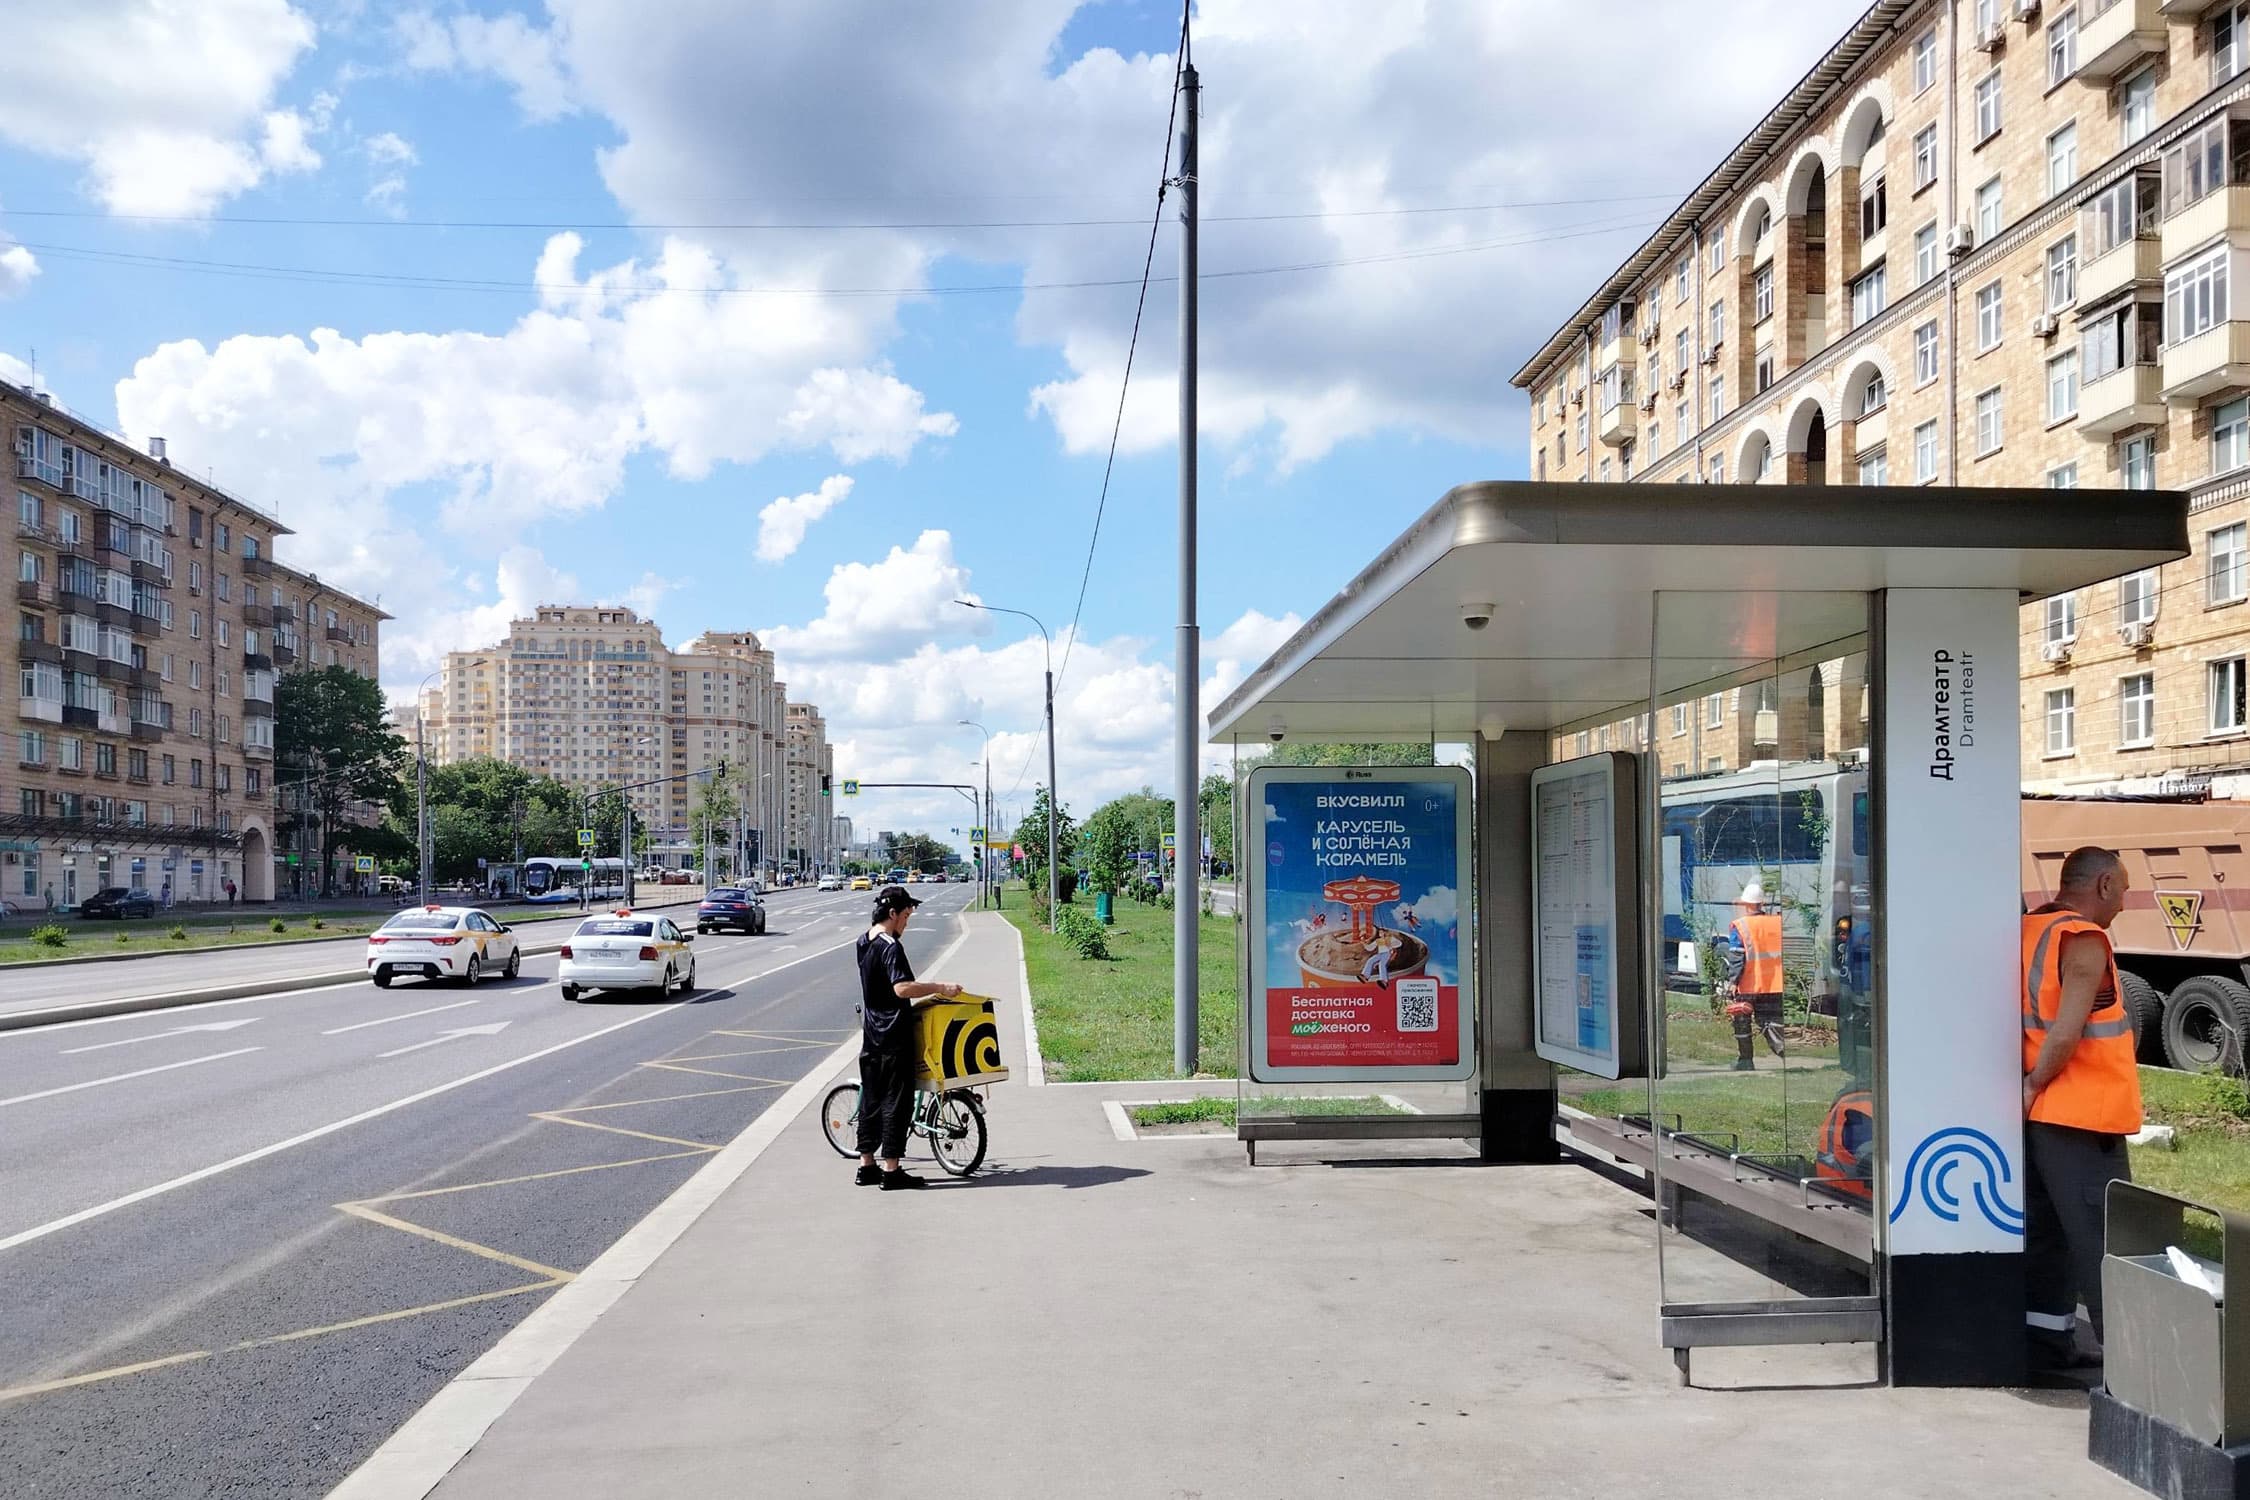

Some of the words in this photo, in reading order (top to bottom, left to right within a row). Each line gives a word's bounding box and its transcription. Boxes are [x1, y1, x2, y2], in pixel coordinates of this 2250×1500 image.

[1959, 651, 1974, 747] Dramteatr
[1930, 649, 1954, 780] Драмтеатр
[1316, 795, 1405, 808] ВКУСВИЛЛ
[1425, 799, 1440, 812] 0+
[1316, 820, 1406, 834] КАРУСЕЛЬ
[1312, 837, 1321, 850] И
[1291, 996, 1373, 1007] Бесплатная
[1291, 1010, 1355, 1021] доставка
